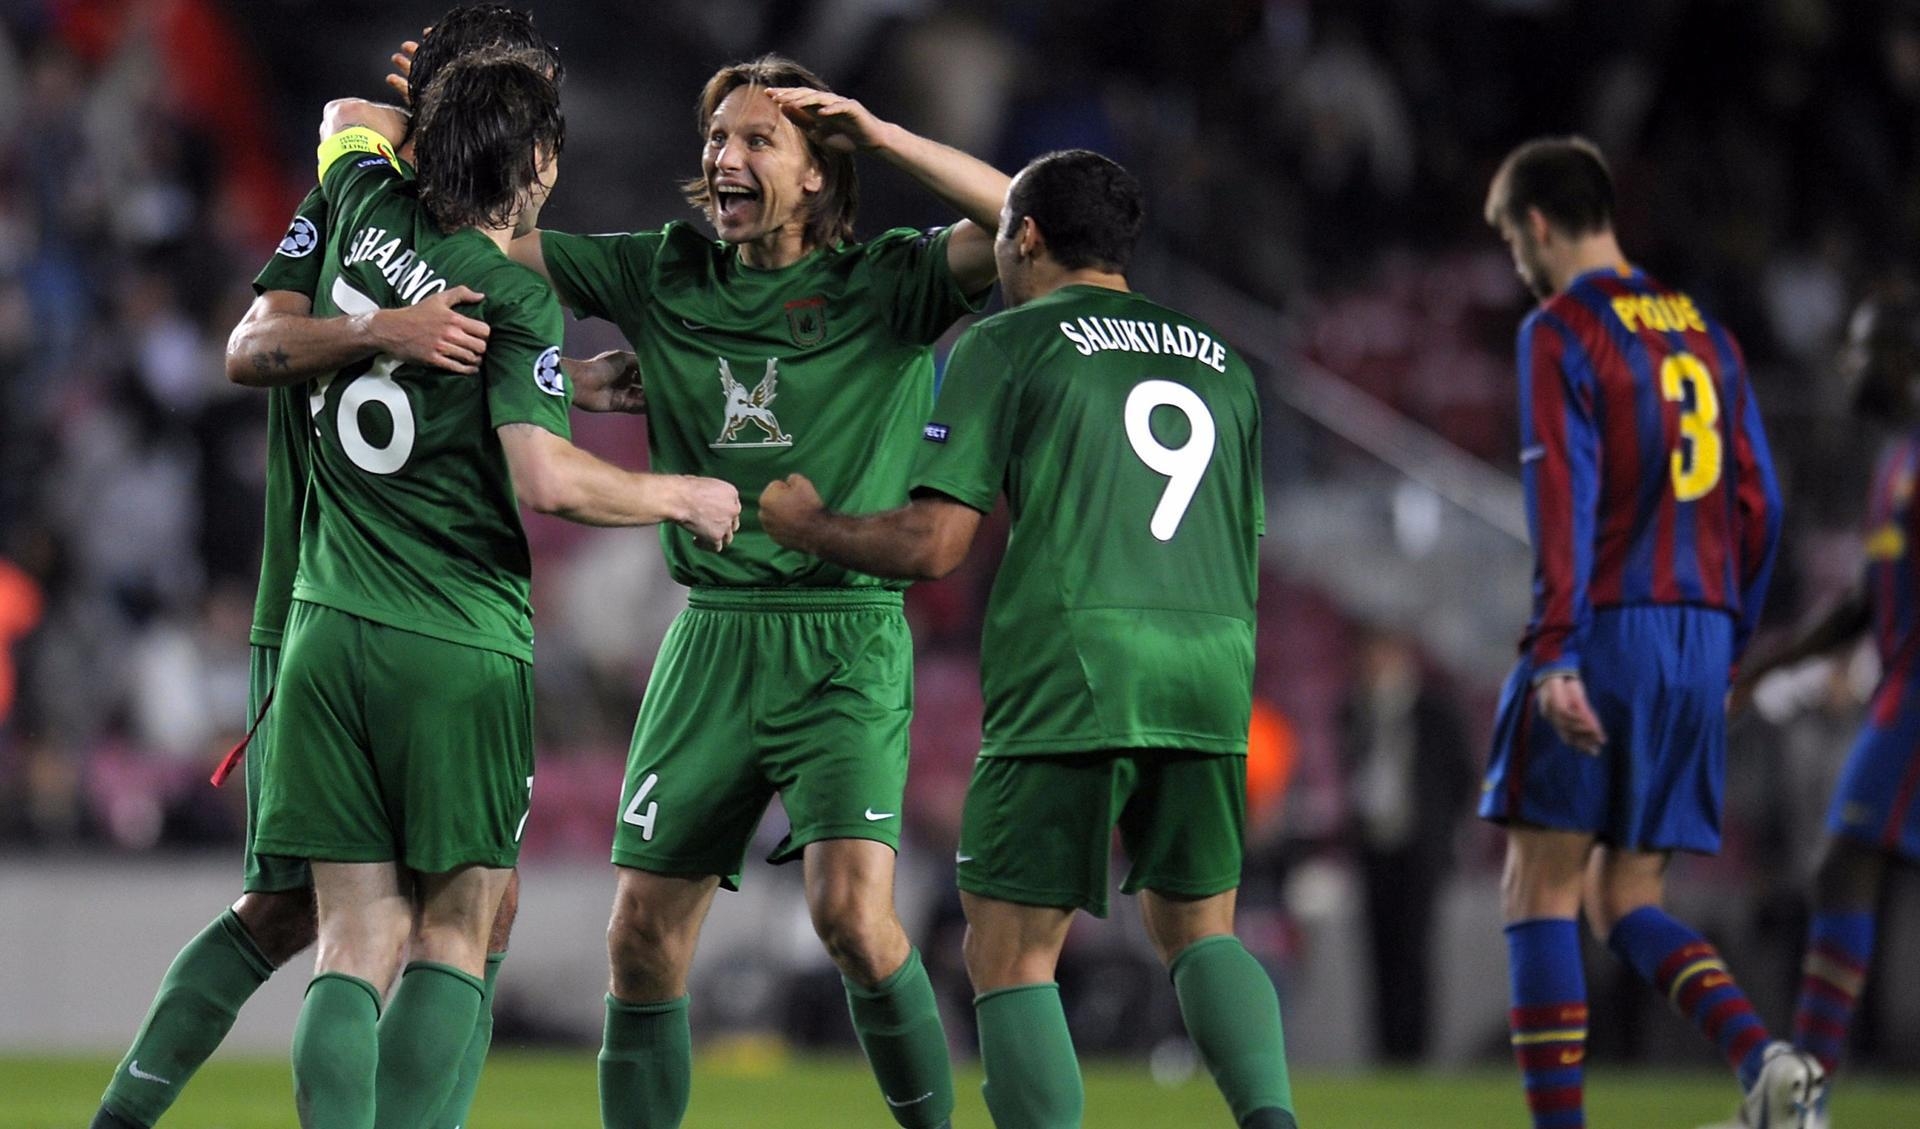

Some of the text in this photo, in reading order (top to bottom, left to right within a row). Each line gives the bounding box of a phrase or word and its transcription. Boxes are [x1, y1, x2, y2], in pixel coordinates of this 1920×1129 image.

[344, 227, 447, 306] SHARNO
[1060, 316, 1226, 373] SALUKVADZE
[924, 427, 947, 439] ECT
[1124, 379, 1216, 541] 9
[1661, 354, 1722, 501] 3
[623, 773, 658, 841] 4
